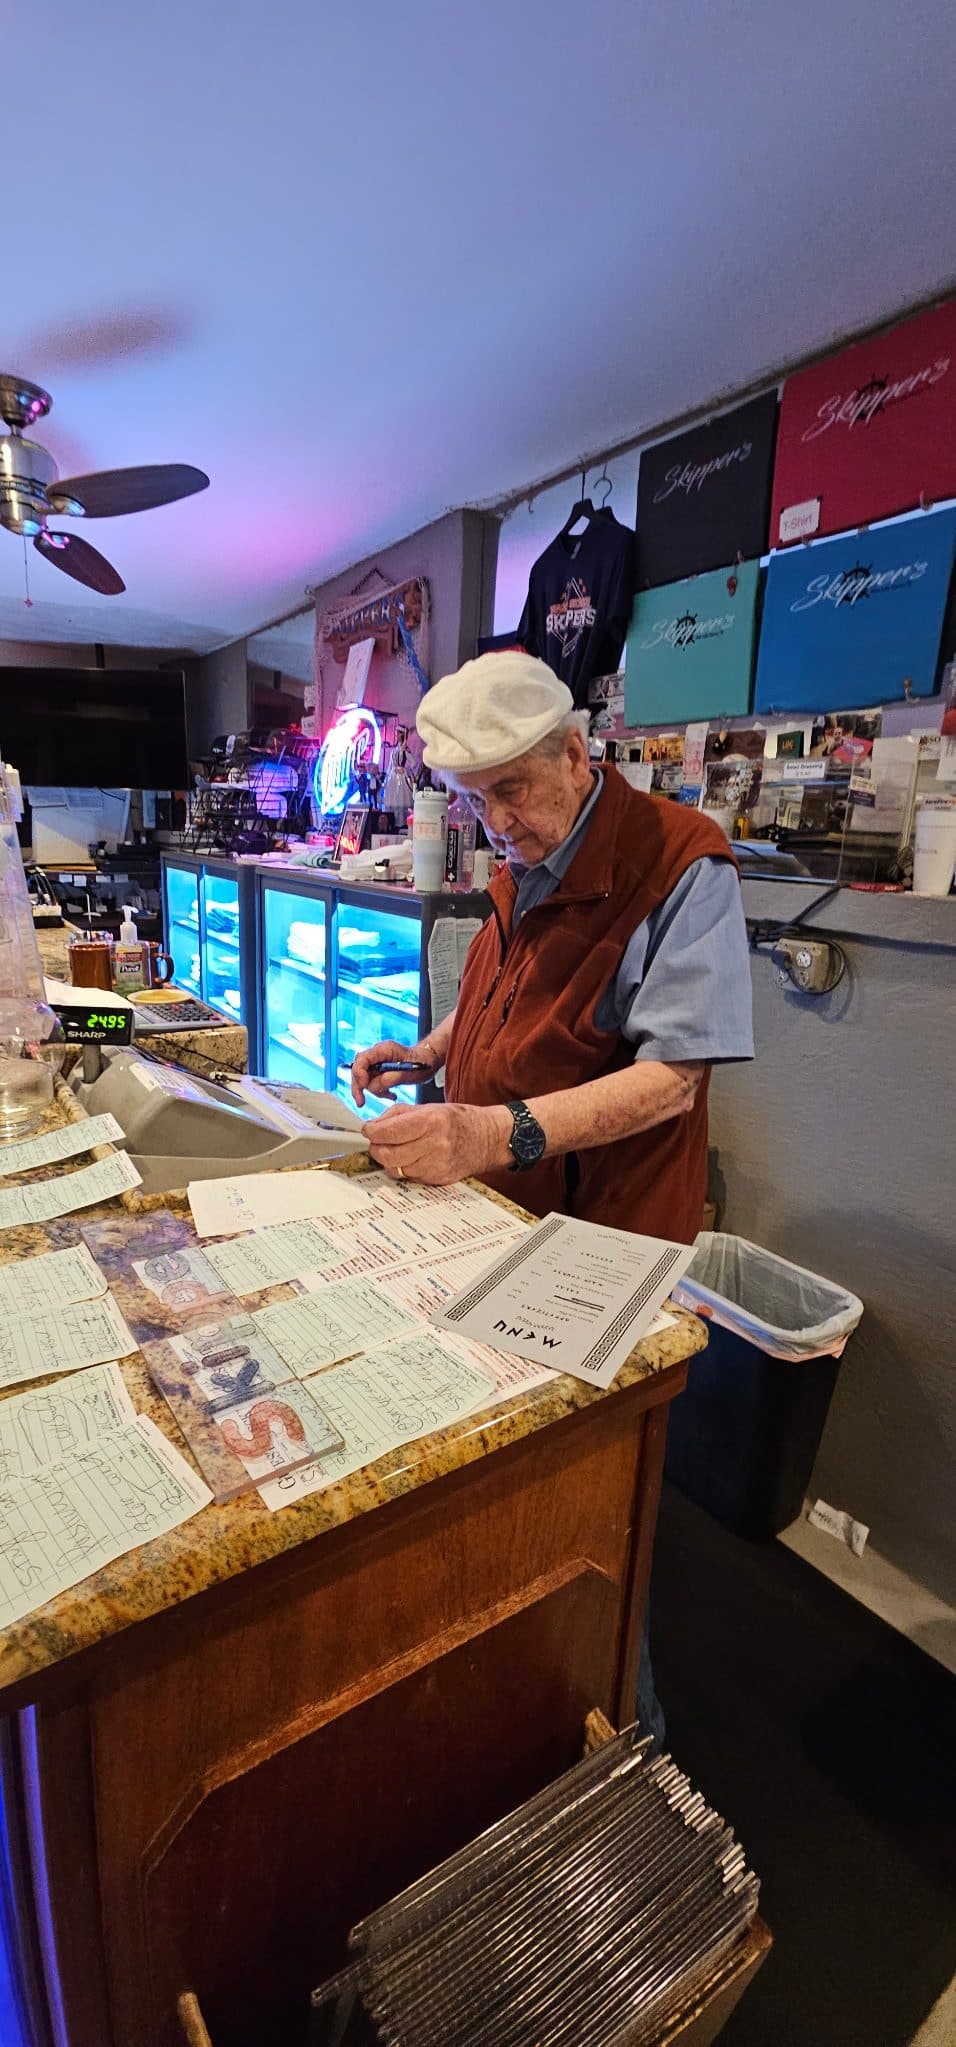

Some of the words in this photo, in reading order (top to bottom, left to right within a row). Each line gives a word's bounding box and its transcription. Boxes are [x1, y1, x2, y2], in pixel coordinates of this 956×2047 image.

[802, 358, 951, 443] Skipper's
[653, 441, 752, 503] Skipper's
[790, 560, 929, 613] Skipper's
[640, 614, 735, 650] Skipper's
[66, 1030, 107, 1040] SHARP
[493, 1319, 562, 1349] MENU
